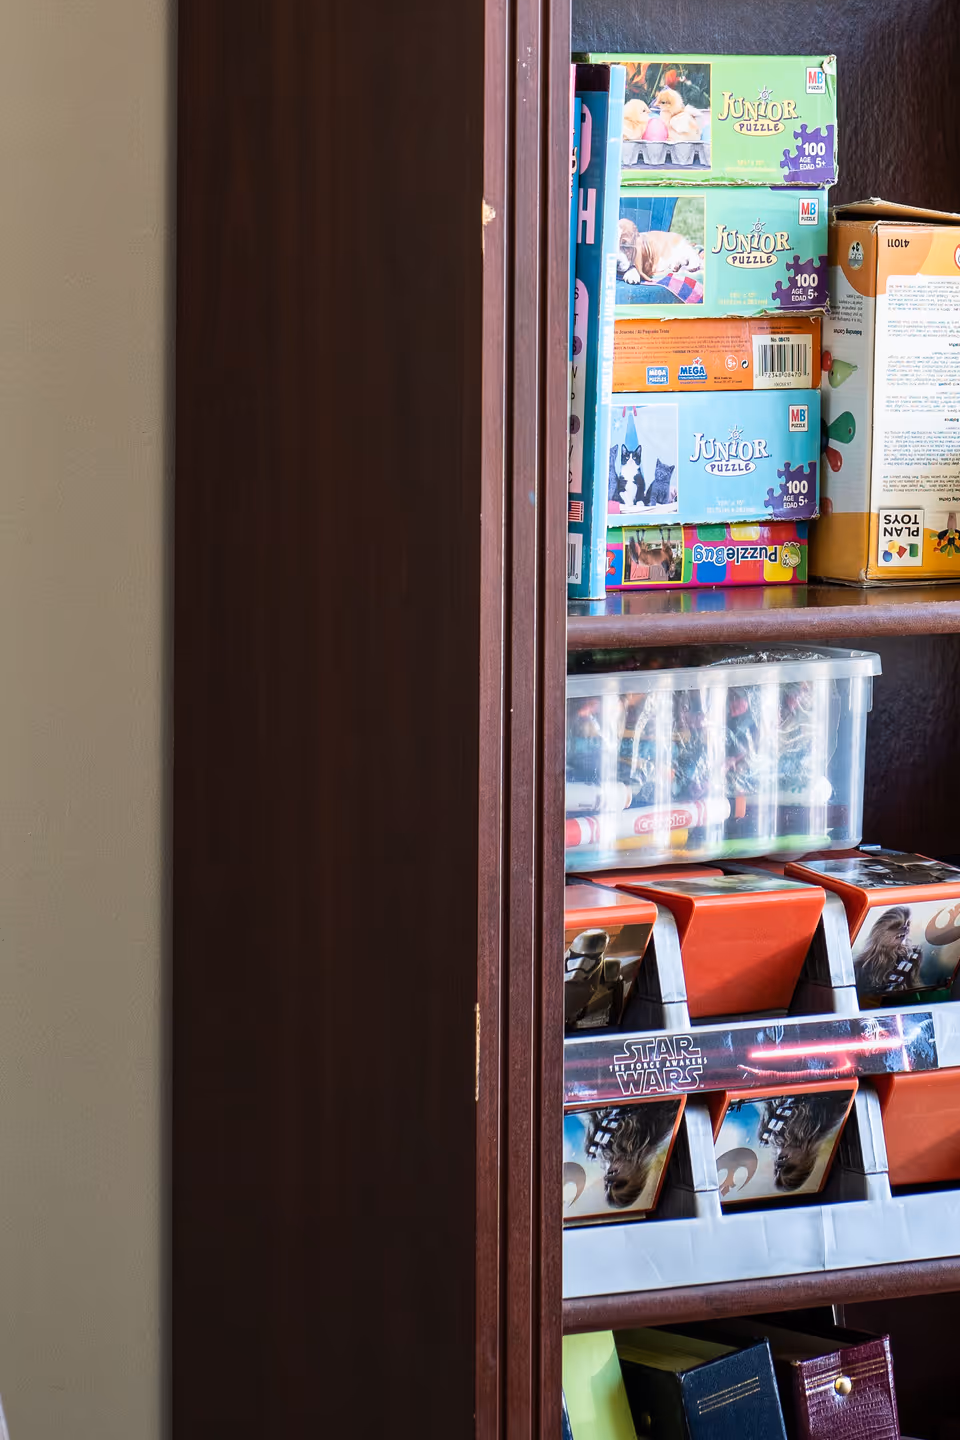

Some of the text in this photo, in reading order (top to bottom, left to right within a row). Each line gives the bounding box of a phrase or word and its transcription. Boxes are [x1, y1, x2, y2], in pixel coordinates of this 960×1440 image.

[808, 71, 823, 84] MB
[738, 123, 780, 132] PUZZLE
[803, 142, 826, 156] 100
[815, 157, 826, 168] 5+
[801, 202, 816, 216] MB
[887, 238, 910, 249] 41011
[731, 255, 773, 265] PUZZLE
[795, 273, 819, 287] 100
[807, 289, 818, 299] 5+
[727, 358, 737, 368] 5+
[680, 366, 705, 375] MEGA
[791, 409, 806, 422] MB
[710, 462, 751, 472] PUZZLE
[786, 480, 808, 494] 100
[798, 495, 808, 506] 5+
[883, 514, 920, 525] TOYS
[883, 526, 920, 537] PLAN
[693, 543, 779, 566] PuzzleBug
[638, 814, 687, 831] Crola
[613, 1035, 701, 1065] STAR
[608, 1056, 708, 1072] THE FORCE AWAKENS
[616, 1065, 704, 1095] WARS
